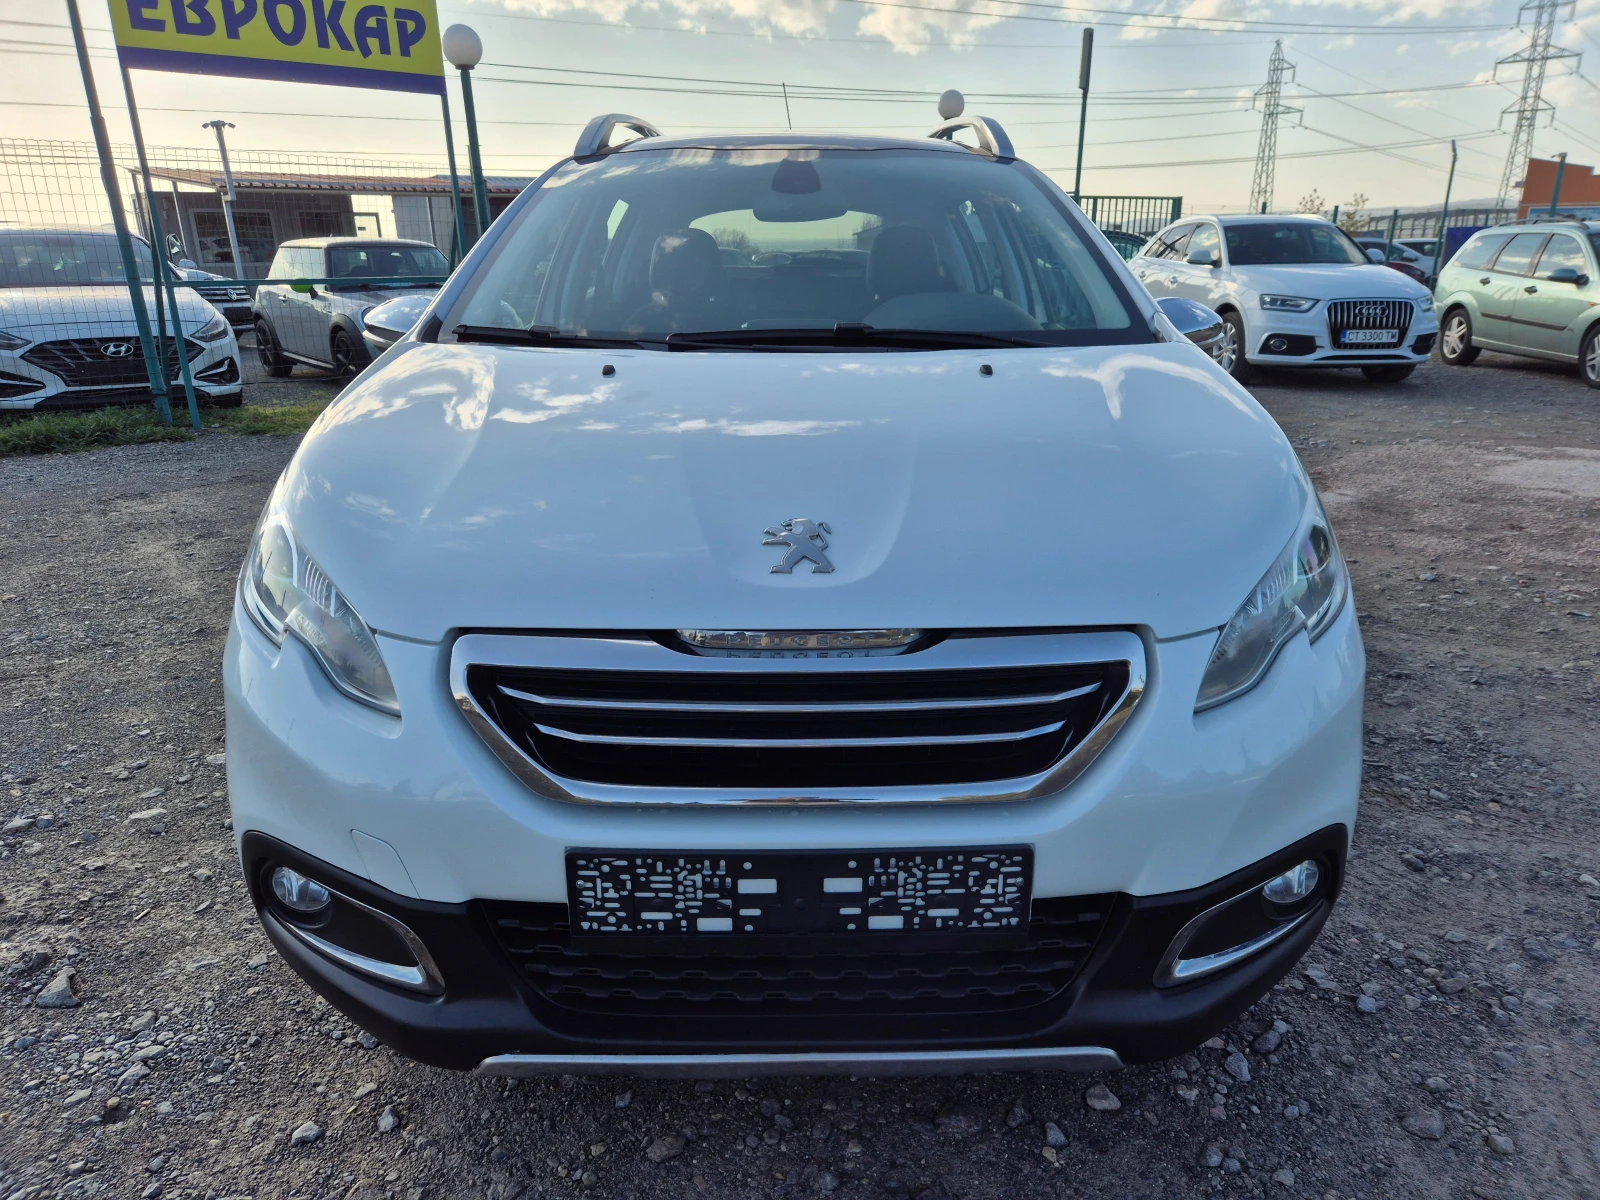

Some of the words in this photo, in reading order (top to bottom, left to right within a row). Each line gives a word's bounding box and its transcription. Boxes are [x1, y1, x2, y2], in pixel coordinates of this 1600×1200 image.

[125, 0, 426, 59] ЕВРОКАР
[1348, 331, 1360, 341] CT
[1362, 331, 1384, 341] 3300
[725, 634, 876, 647] PEUGEOT
